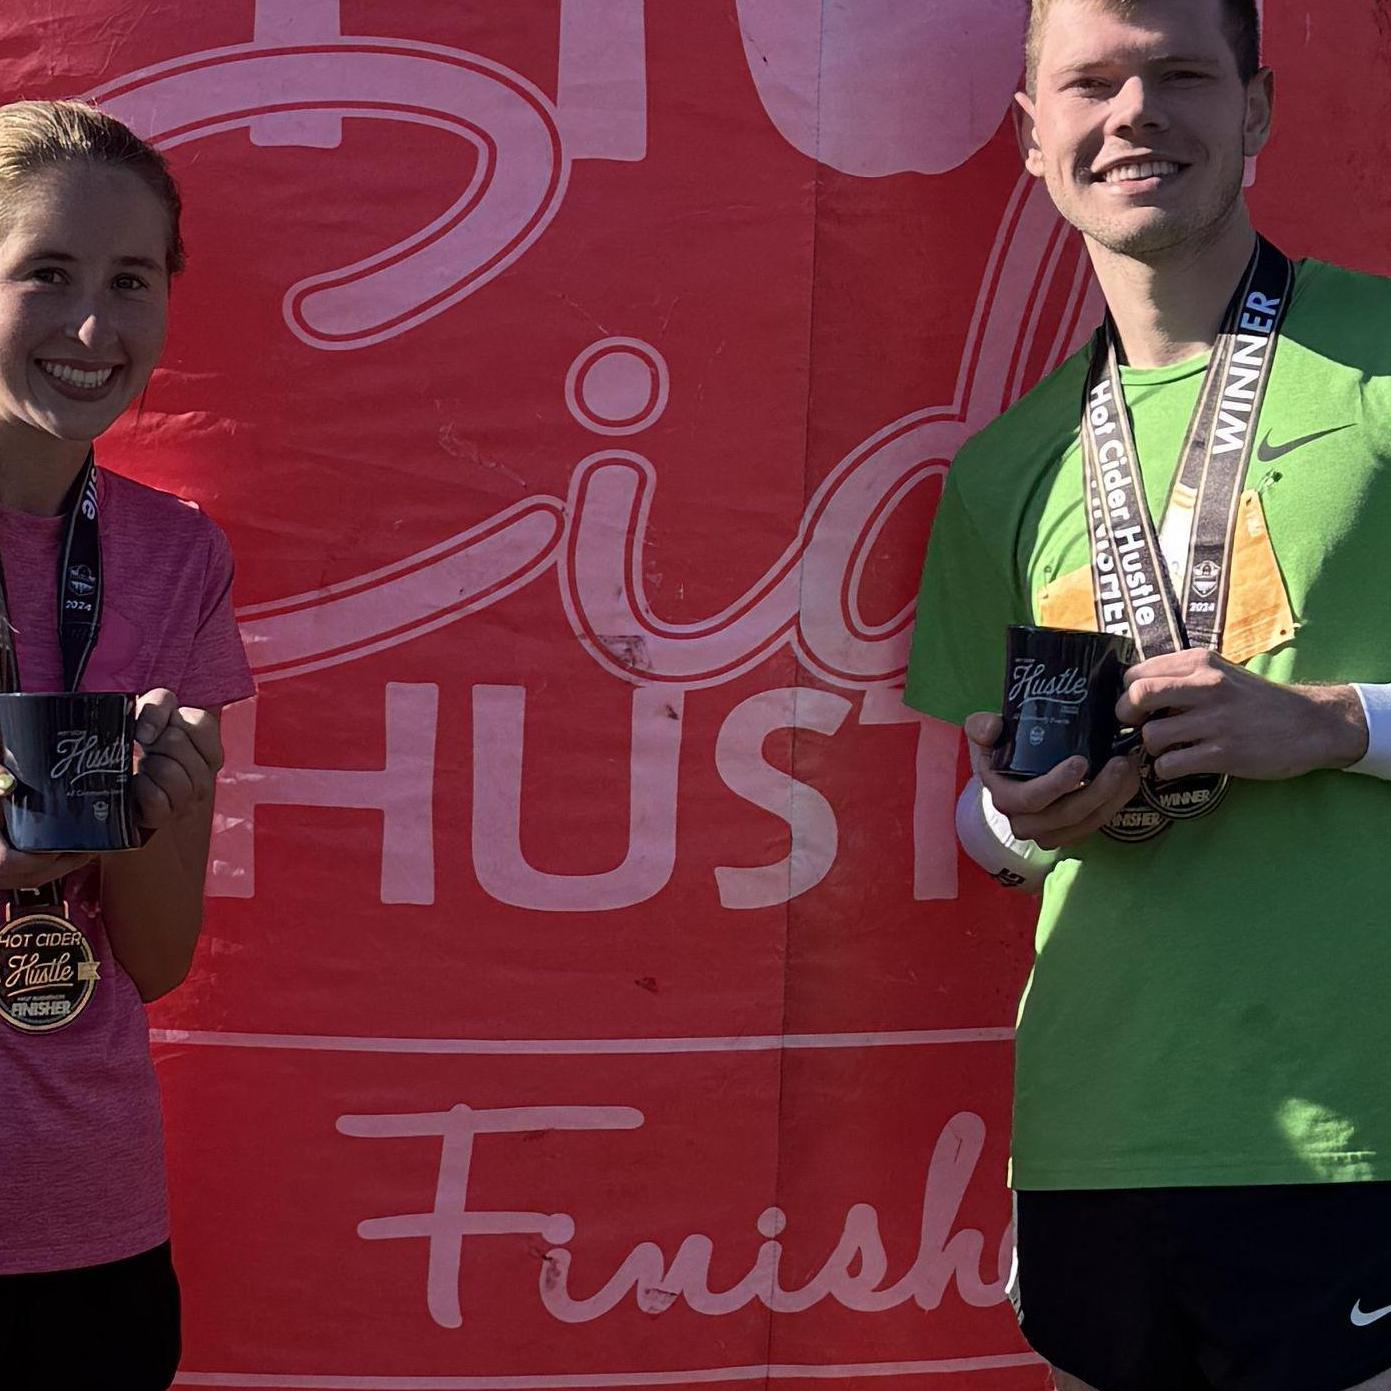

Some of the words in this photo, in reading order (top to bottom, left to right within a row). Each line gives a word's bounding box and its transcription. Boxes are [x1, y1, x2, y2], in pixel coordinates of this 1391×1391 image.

[1212, 291, 1281, 455] WINNER
[1090, 379, 1113, 436] Hot
[1098, 439, 1133, 520] Cider
[1114, 525, 1161, 626] Hustle
[65, 599, 92, 611] 2024
[1189, 601, 1215, 612] 2024
[1009, 663, 1088, 706] Hustle
[206, 681, 959, 912] HUST
[1159, 789, 1210, 807] WINNER
[35, 931, 83, 948] CIDER
[5, 952, 74, 988] Hustle
[11, 1000, 71, 1017] FINISHER
[335, 1103, 1016, 1329] Finish
